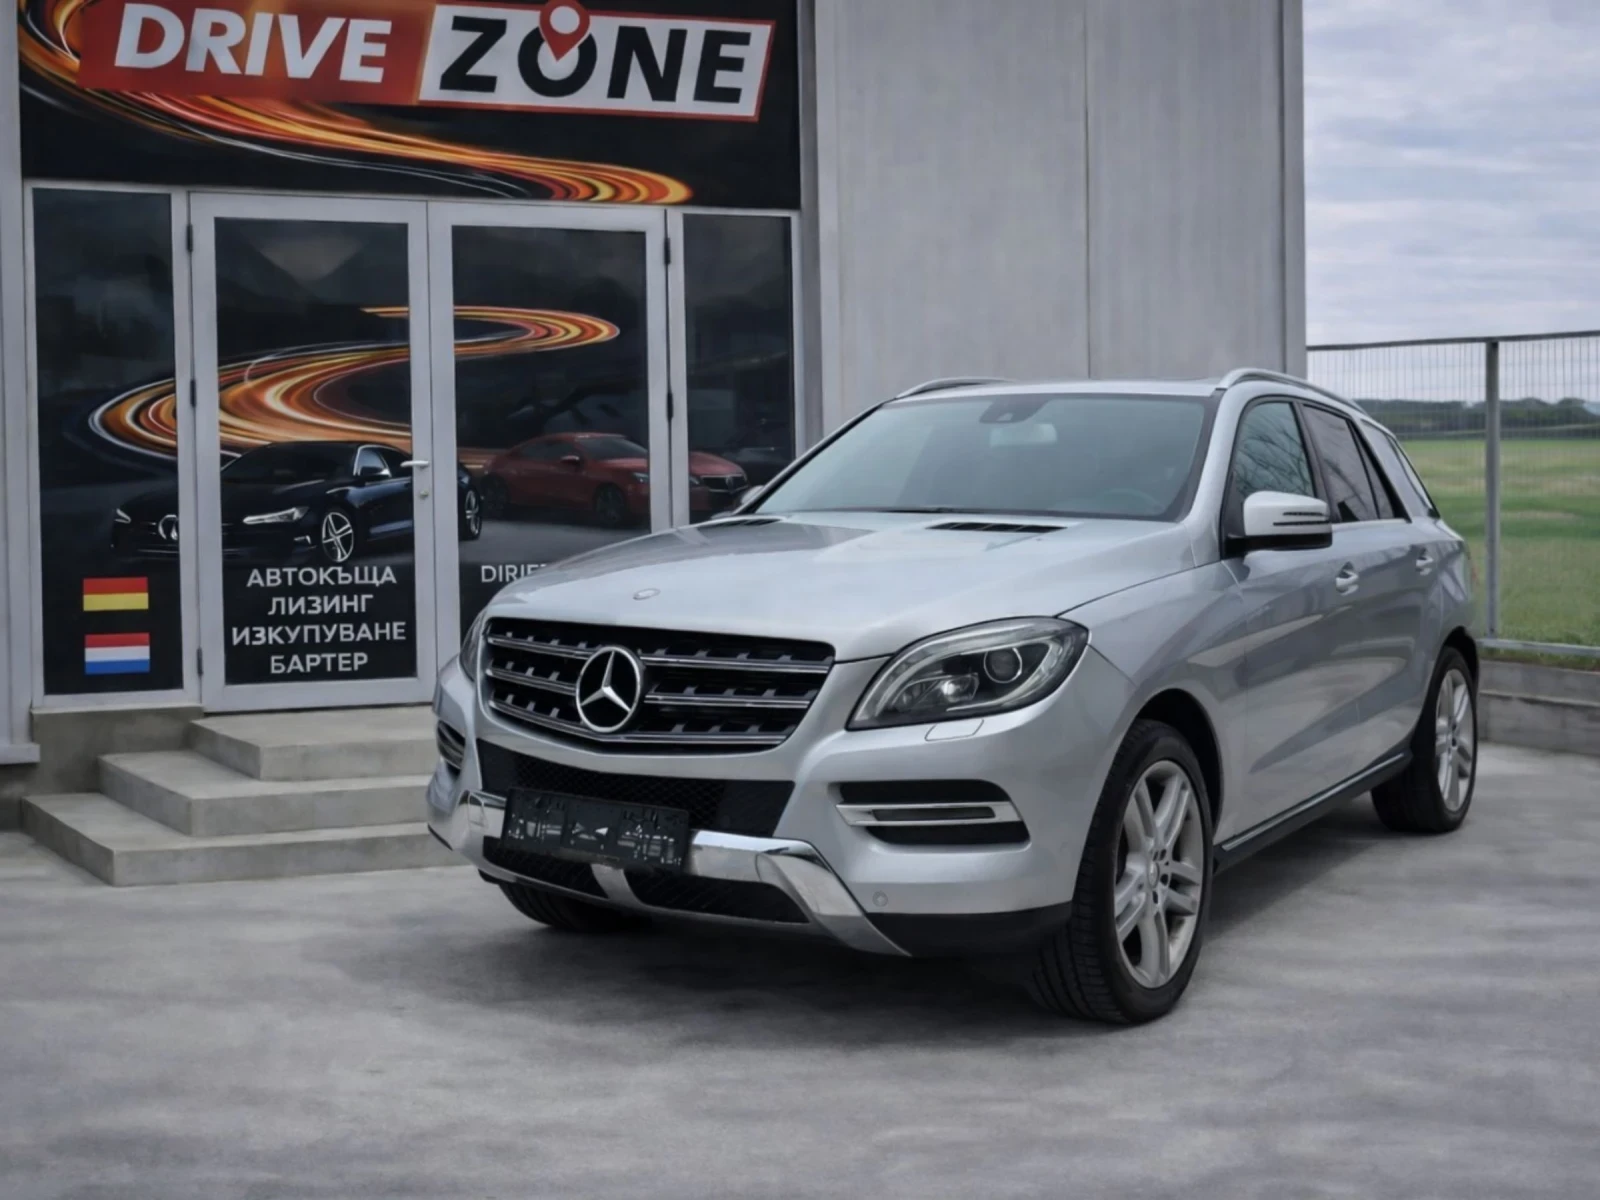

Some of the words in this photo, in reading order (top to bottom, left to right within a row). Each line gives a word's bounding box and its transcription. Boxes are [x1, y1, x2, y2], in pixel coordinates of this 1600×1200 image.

[115, 3, 393, 84] DRIVE
[440, 16, 752, 104] ZONE
[246, 565, 397, 588] АВТОКЪЩА
[481, 564, 547, 583] DIRI
[267, 594, 374, 616] ЛИЗИНГ
[232, 621, 407, 646] ИЗКУПУВАНЕ
[270, 652, 369, 675] БАРТЕР
